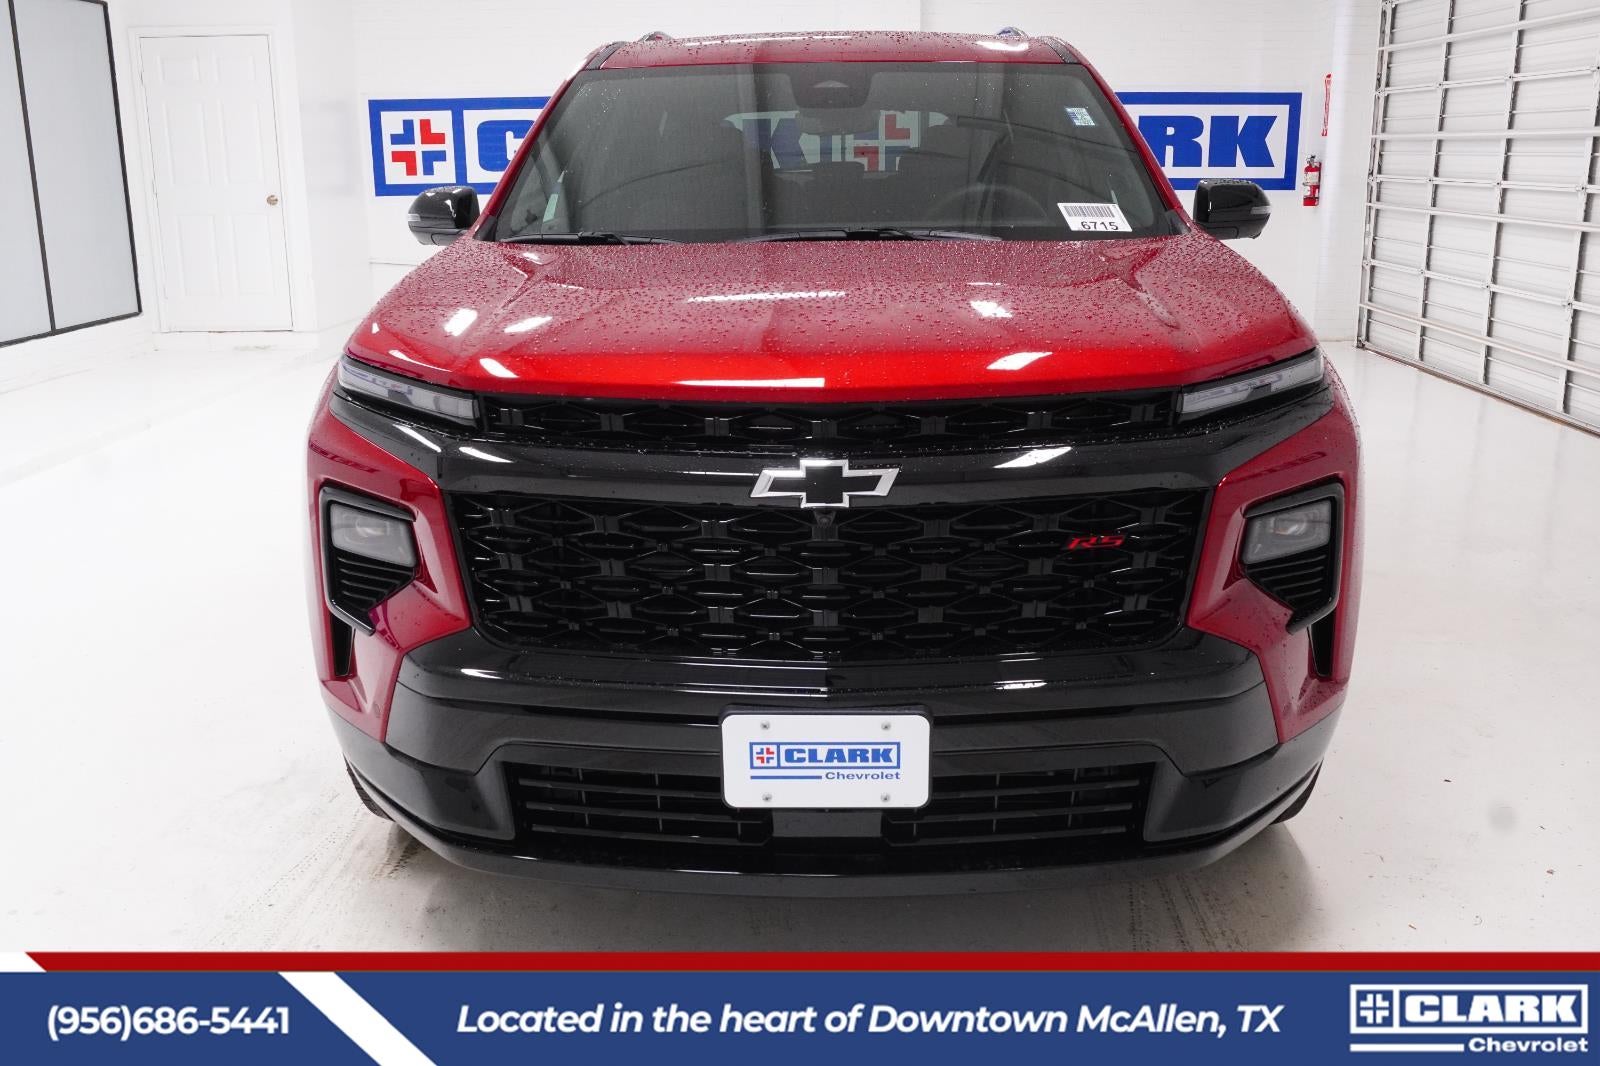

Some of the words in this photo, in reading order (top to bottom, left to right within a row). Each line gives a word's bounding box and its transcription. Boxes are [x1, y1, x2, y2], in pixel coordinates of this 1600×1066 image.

[1080, 221, 1119, 231] 6715
[1066, 534, 1125, 550] RS
[784, 748, 894, 764] CLARK
[824, 770, 902, 781] Chevrolet
